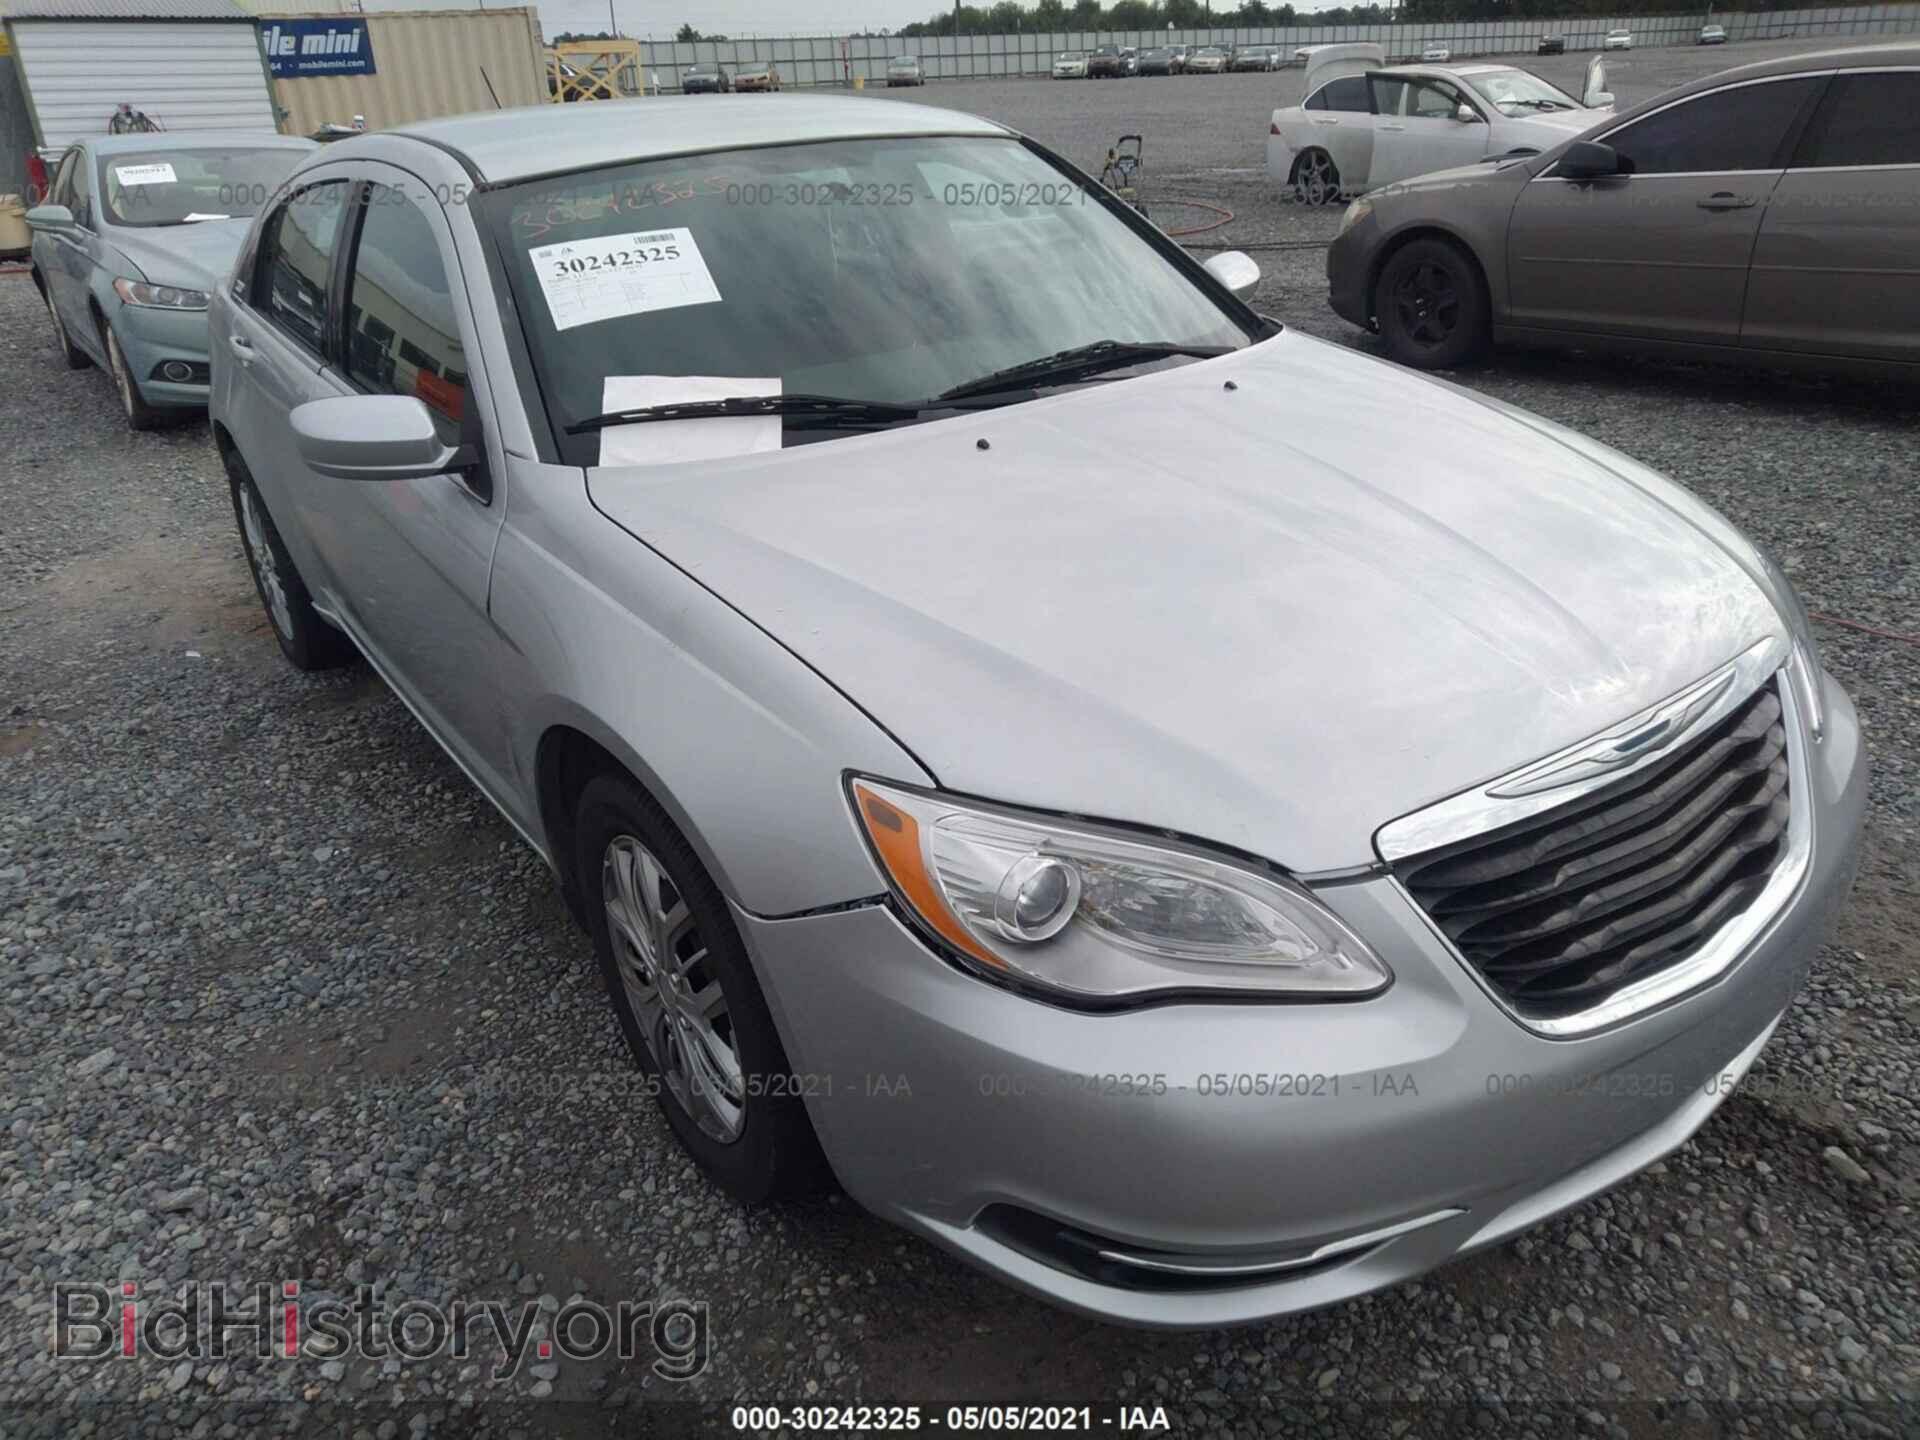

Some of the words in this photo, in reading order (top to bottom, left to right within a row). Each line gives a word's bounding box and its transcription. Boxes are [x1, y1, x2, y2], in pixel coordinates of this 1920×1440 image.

[301, 28, 361, 55] mini
[299, 59, 366, 69] mobilemini.com
[553, 245, 681, 277] 30242325
